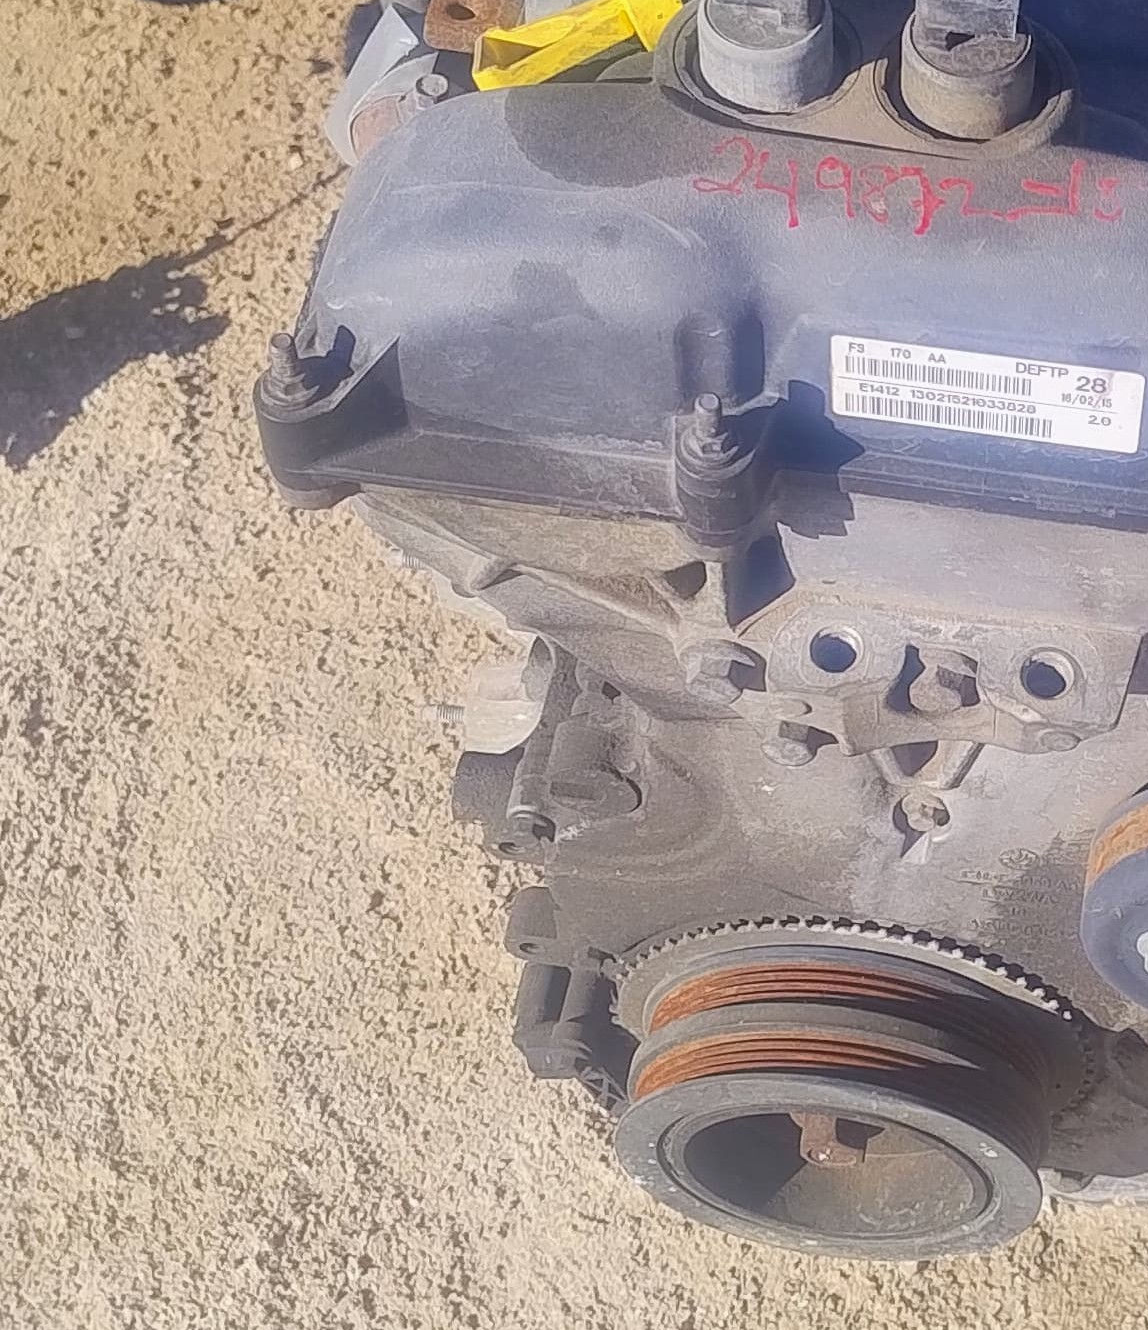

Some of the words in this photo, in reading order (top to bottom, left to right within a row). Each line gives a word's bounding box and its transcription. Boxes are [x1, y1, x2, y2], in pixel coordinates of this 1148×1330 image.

[889, 347, 913, 360] 170
[927, 352, 947, 365] AA
[1015, 362, 1070, 379] DEFTP
[859, 381, 901, 397] E1412
[1075, 375, 1107, 394] 28
